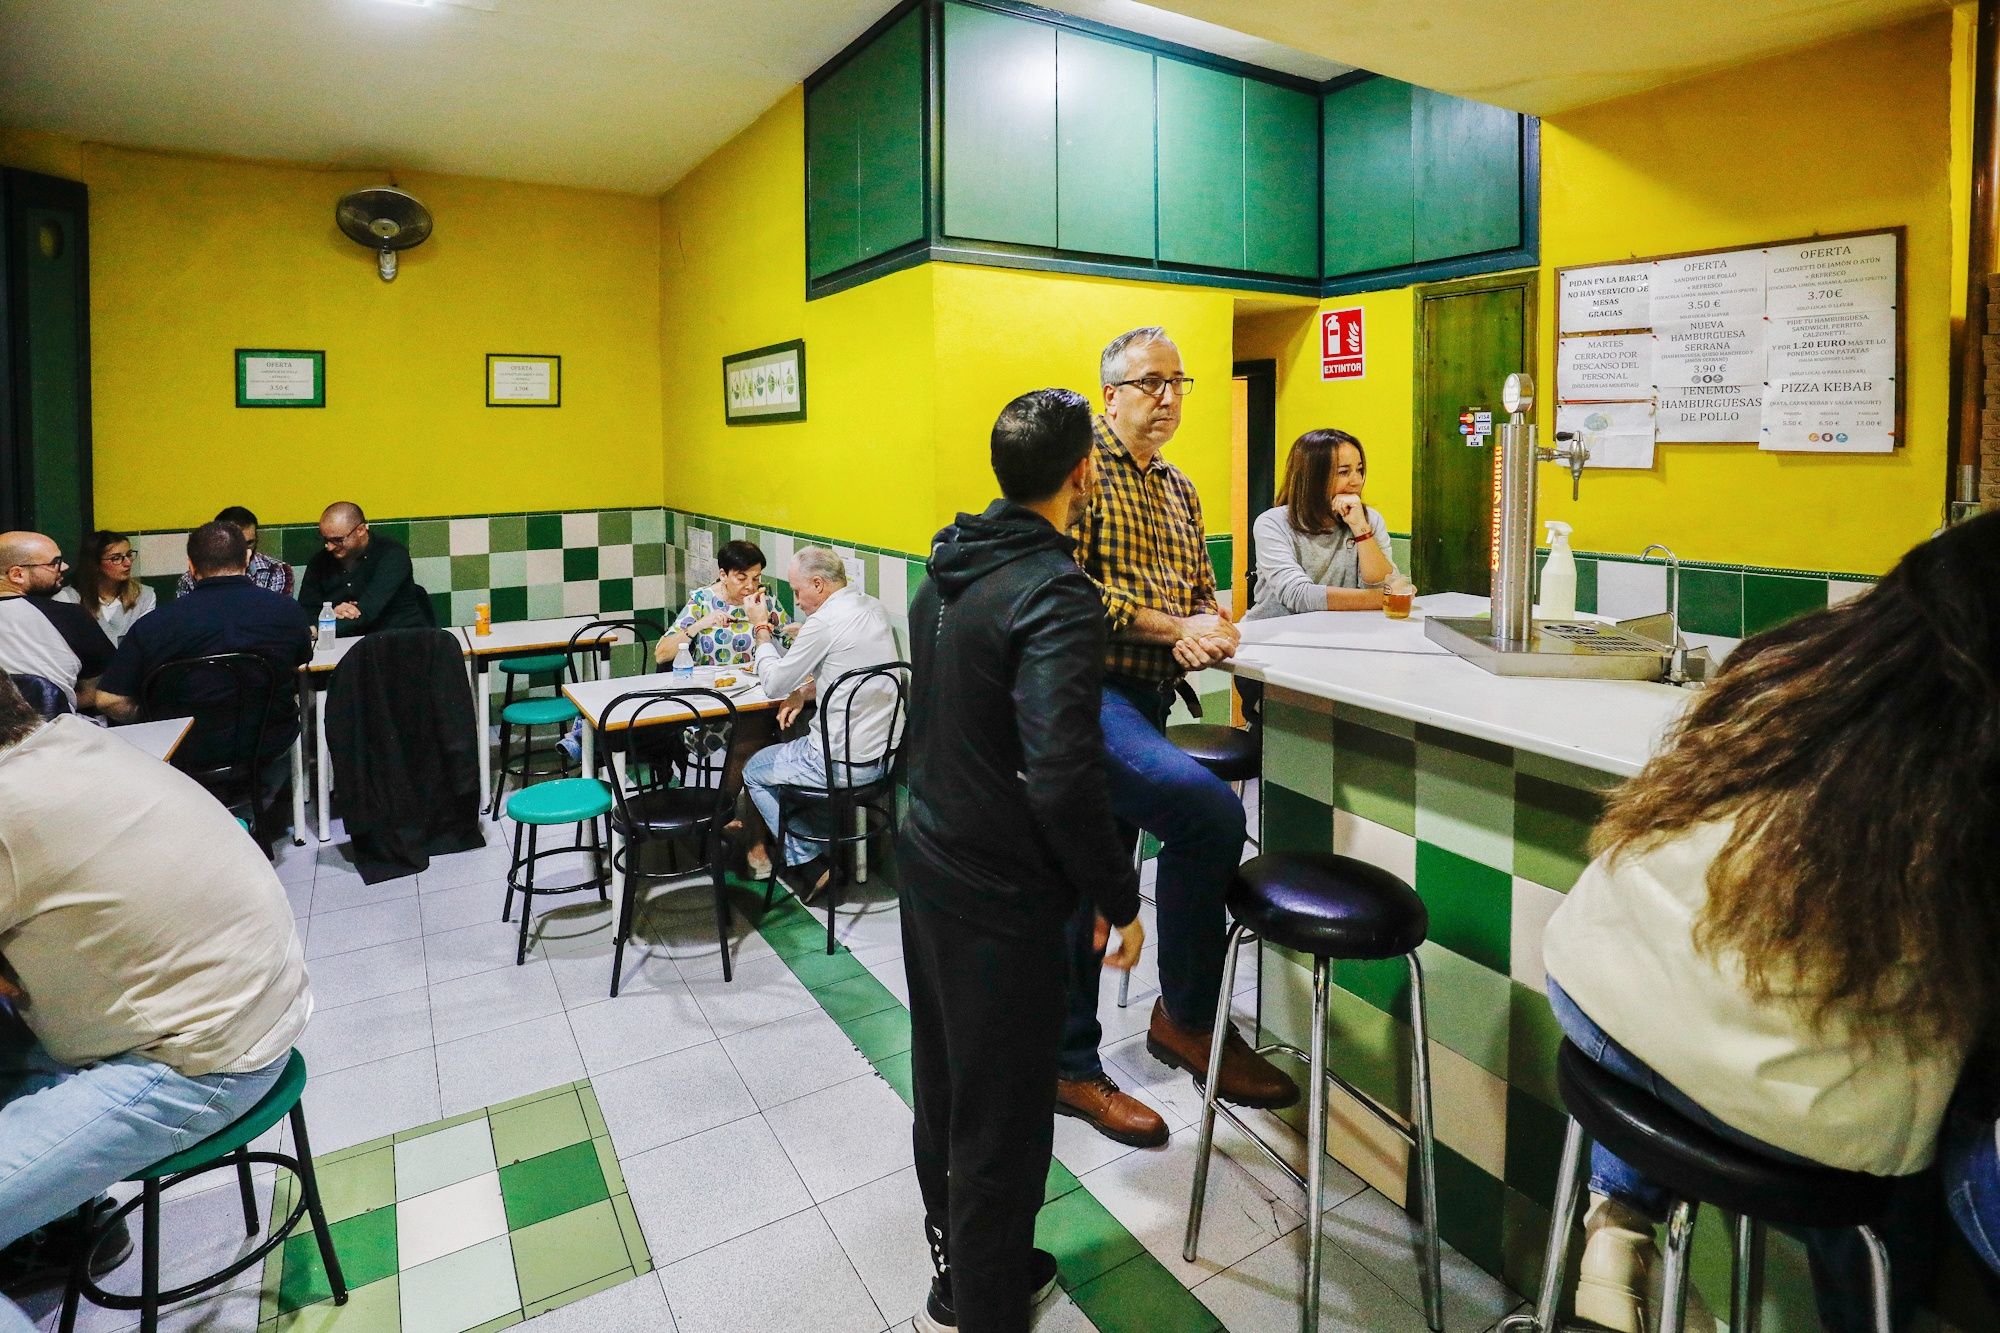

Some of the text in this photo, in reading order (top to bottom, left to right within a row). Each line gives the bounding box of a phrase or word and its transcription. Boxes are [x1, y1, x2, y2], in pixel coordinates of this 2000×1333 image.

[1800, 246, 1852, 260] OFERTA
[1684, 260, 1728, 272] OFERTA
[1774, 264, 1815, 274] CALZONETTI
[1828, 260, 1852, 269] JAMÓN
[1810, 270, 1847, 279] REFRESCO
[1568, 279, 1592, 288] PIDAN
[1594, 276, 1605, 285] EN
[1606, 276, 1617, 284] LA
[1674, 276, 1706, 284] SANDWICH
[1580, 290, 1596, 298] HAY
[1597, 286, 1635, 296] SERVICIO
[1808, 288, 1843, 300] 3.70€
[1592, 298, 1620, 306] MESAS
[1688, 299, 1721, 310] 3.50 €
[1588, 310, 1623, 318] GRACIAS
[1814, 315, 1870, 324] HAMBURGUESA,
[1690, 320, 1724, 330] NUEVA
[1671, 330, 1746, 342] HAMBURGUESA
[1588, 340, 1624, 348] MARTES
[1684, 342, 1730, 352] SERRANA
[1793, 341, 1814, 350] 1.20
[1817, 339, 1846, 348] EURO
[1574, 352, 1617, 360] CERRADO
[1324, 362, 1362, 374] EXTINTOR
[1572, 362, 1620, 370] DESCANSO
[1694, 364, 1726, 374] 3.90 €
[1582, 372, 1628, 380] PERSONAL
[1681, 386, 1741, 396] TENEMOS
[1781, 382, 1872, 393] PIZZA KEBAB
[1662, 398, 1762, 408] HAMBURGUESAS
[1681, 412, 1739, 422] DE POLLO
